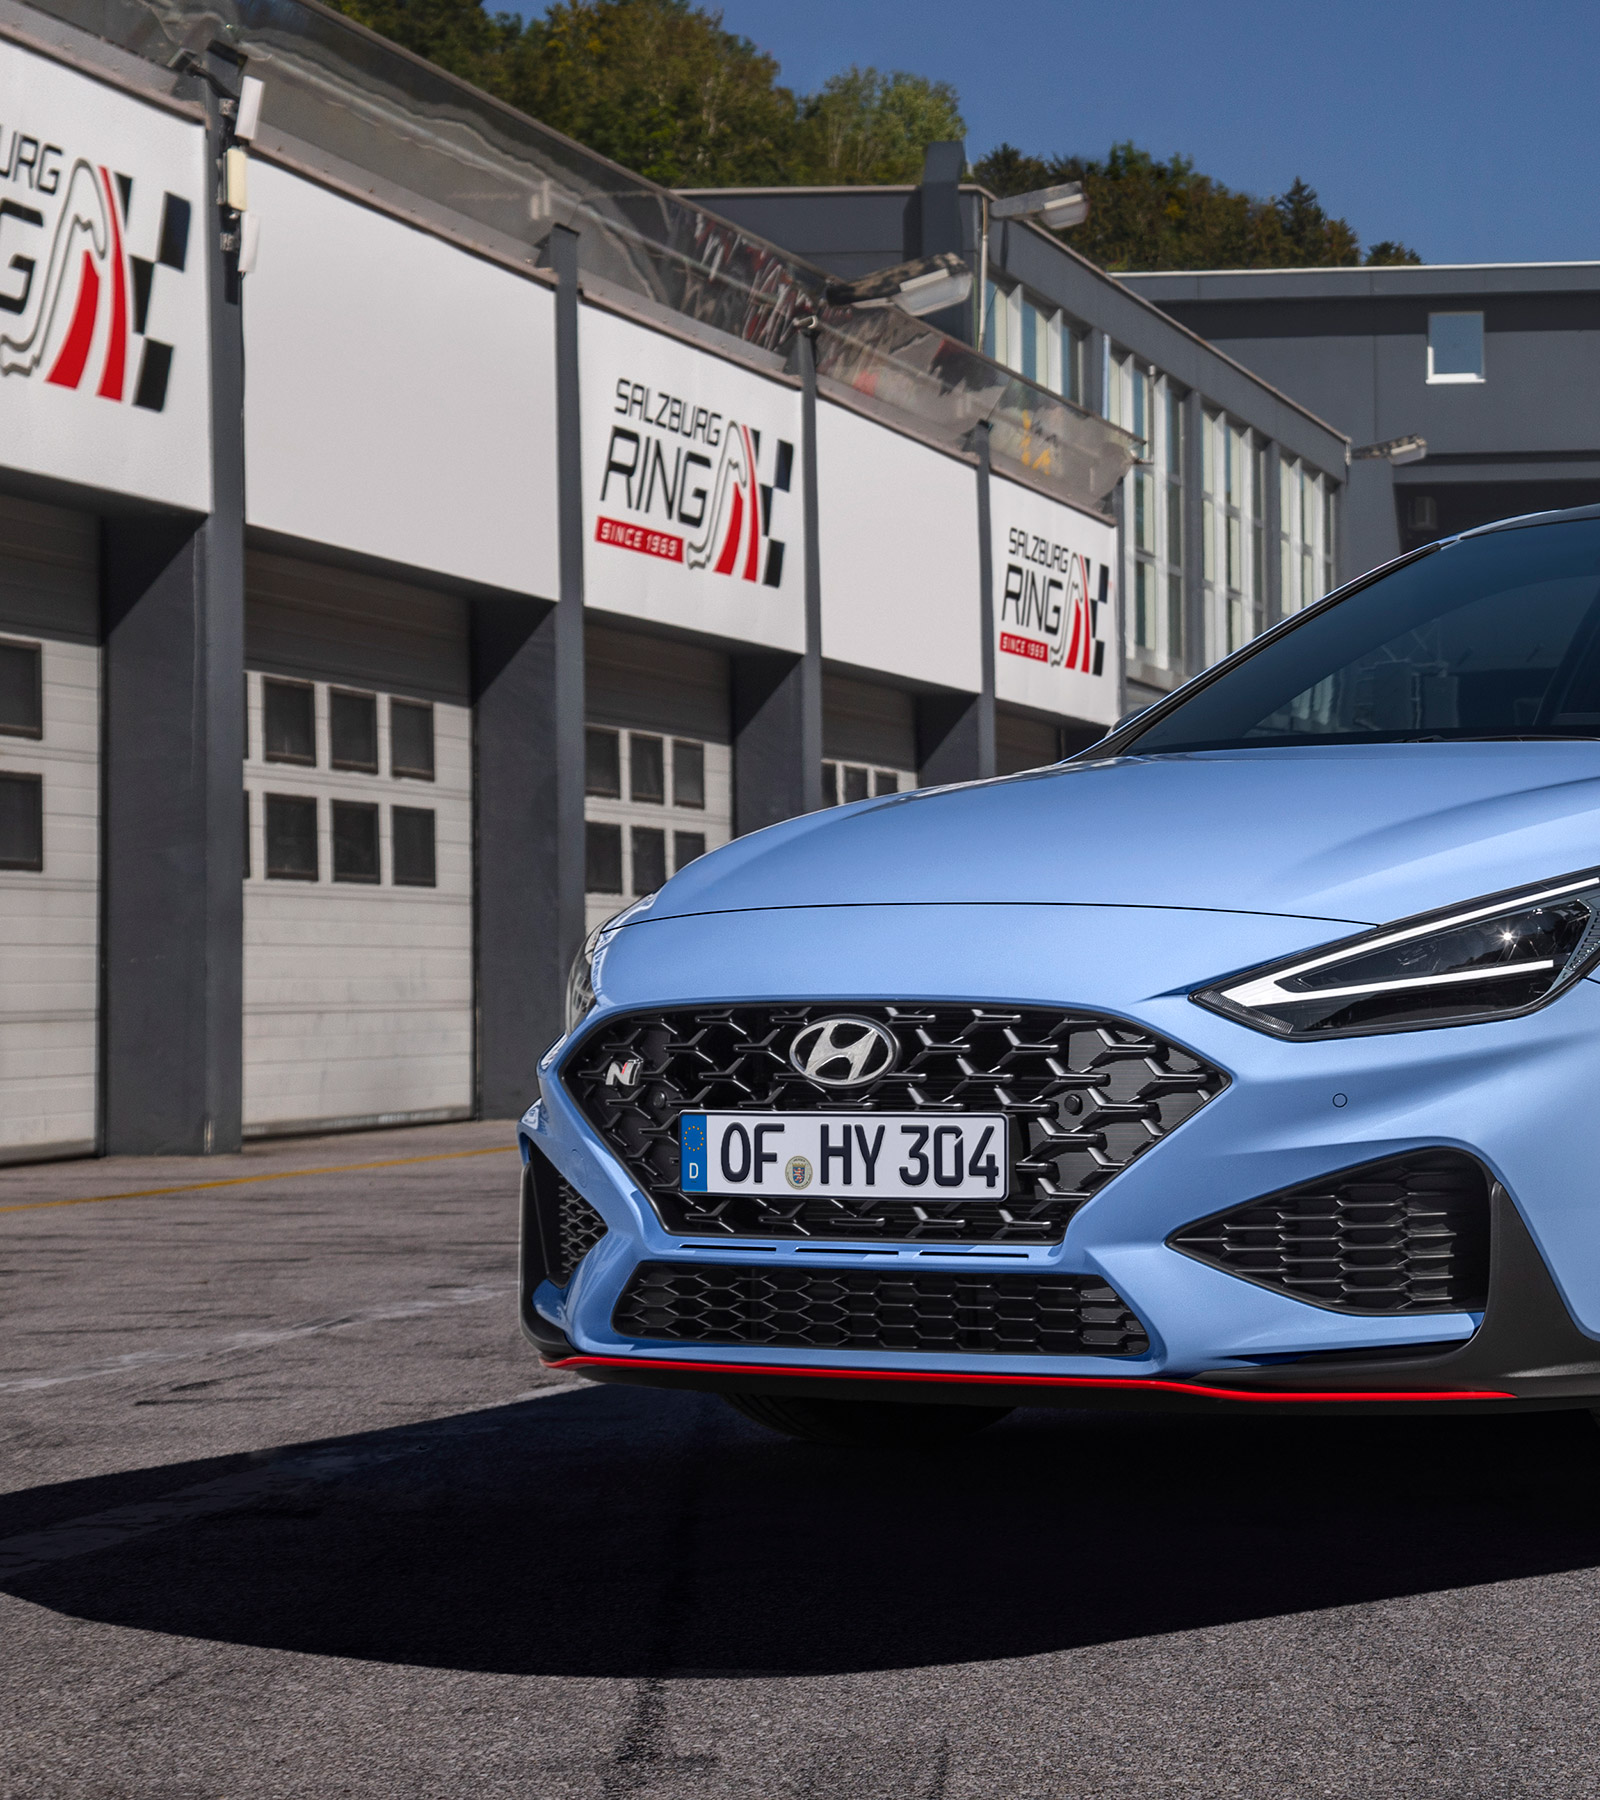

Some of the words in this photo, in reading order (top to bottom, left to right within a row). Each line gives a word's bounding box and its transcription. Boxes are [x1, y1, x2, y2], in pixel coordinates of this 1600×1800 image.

[614, 378, 722, 447] SALZBURG
[600, 425, 711, 528] RING
[600, 521, 644, 549] SINCE
[646, 533, 678, 557] 1969
[1008, 527, 1069, 573] SALZBURG
[1002, 563, 1063, 635] RING
[1002, 636, 1026, 655] SINCE
[689, 1162, 699, 1179] D
[720, 1121, 785, 1185] OF
[820, 1123, 886, 1186] HY
[899, 1124, 999, 1188] 304
